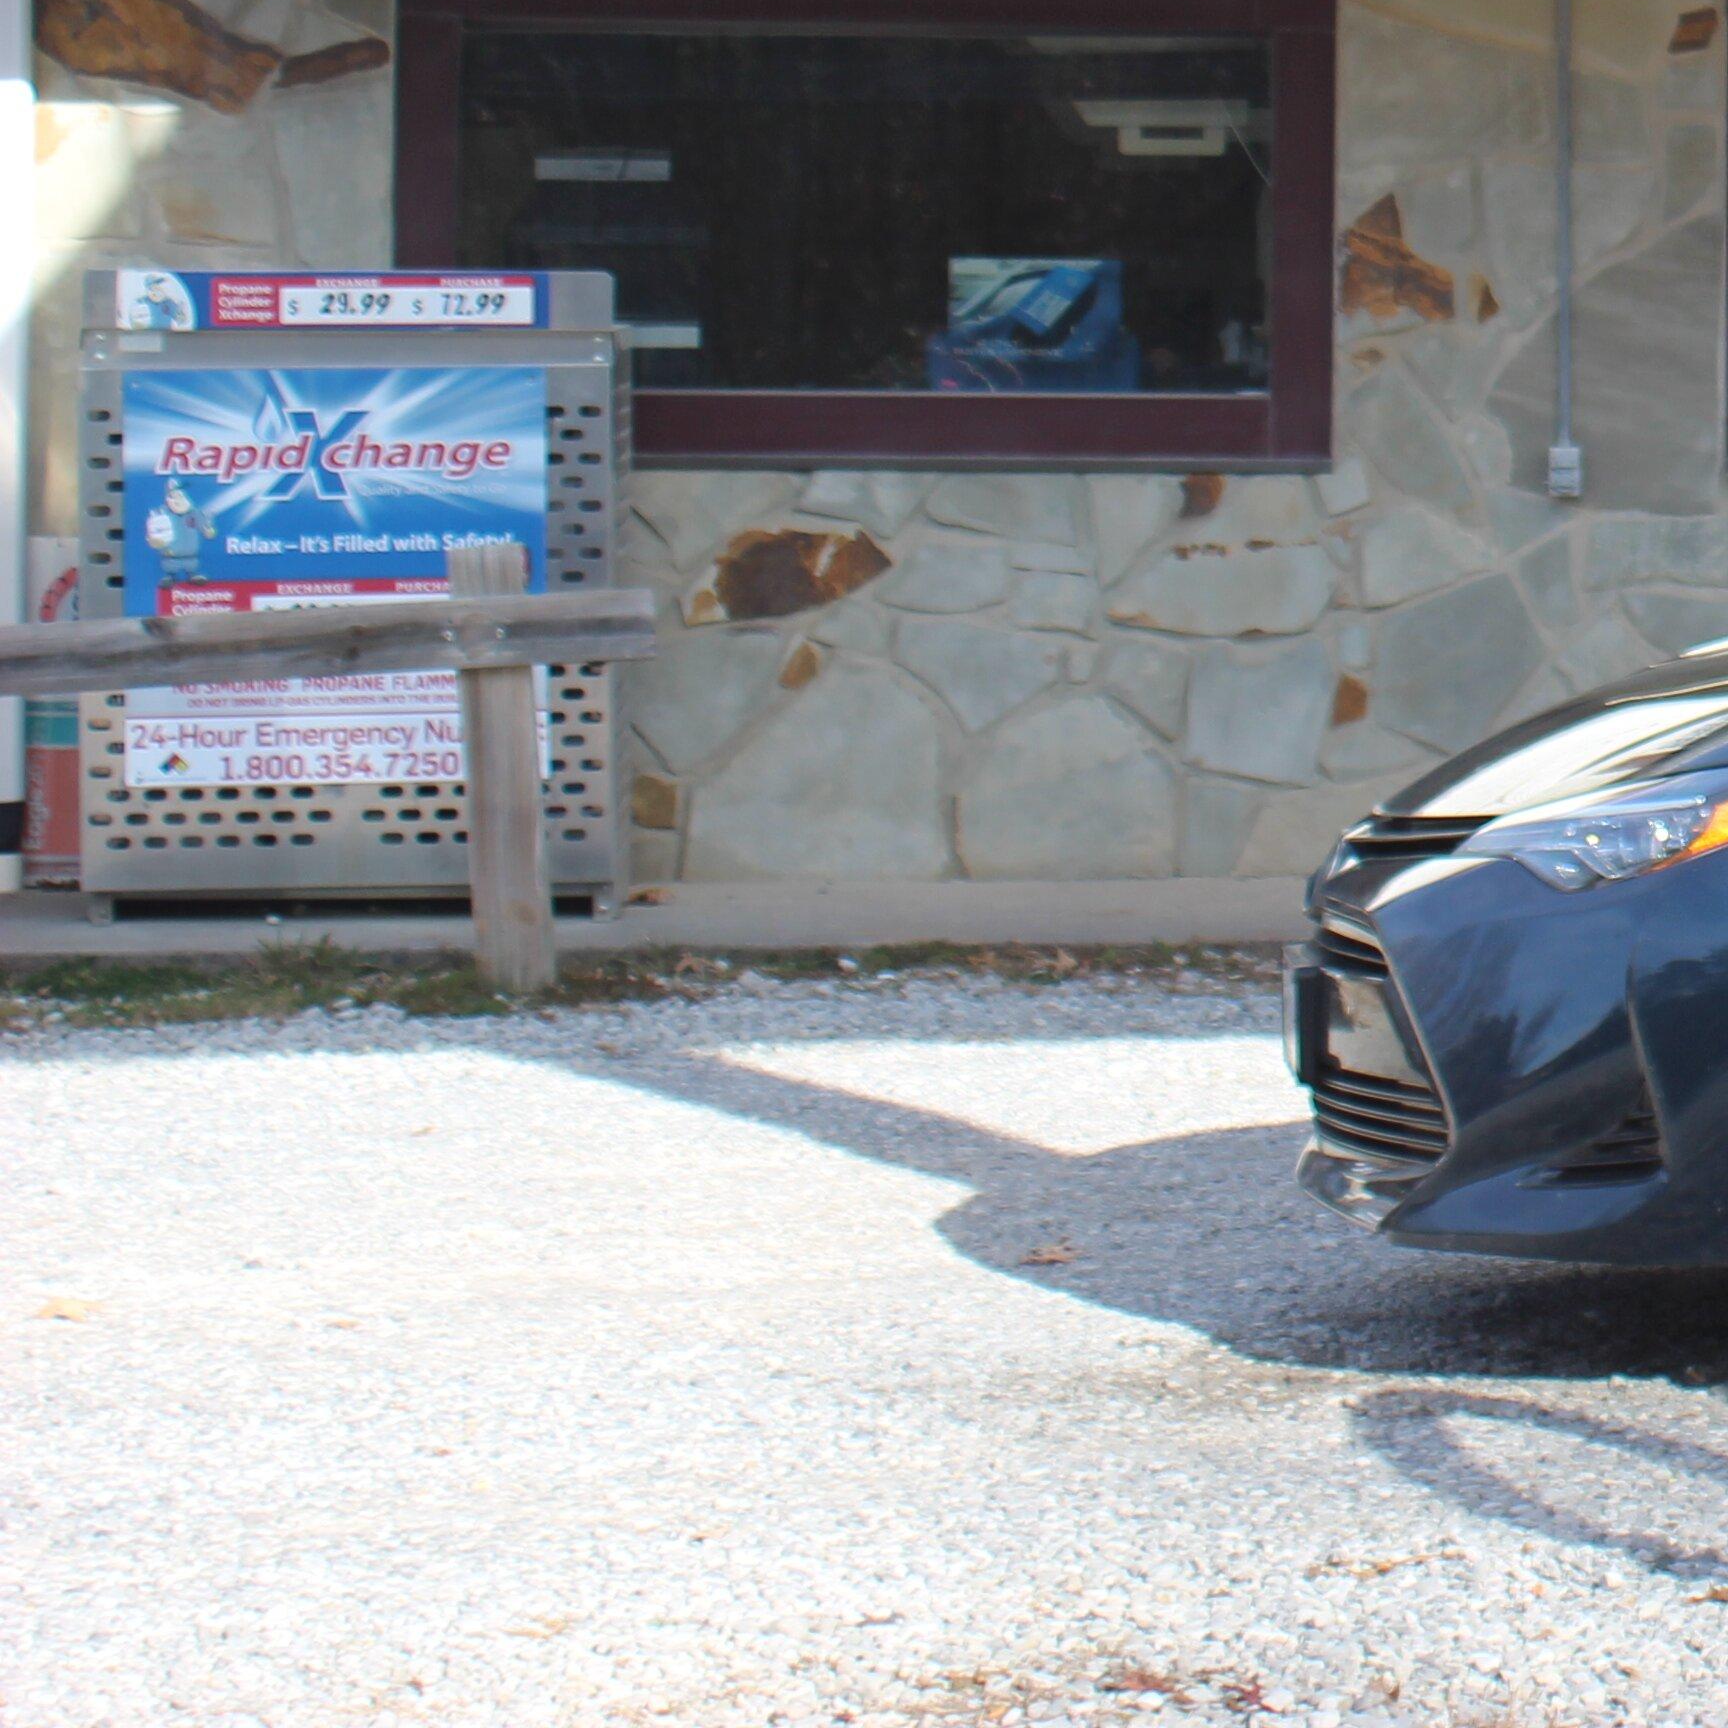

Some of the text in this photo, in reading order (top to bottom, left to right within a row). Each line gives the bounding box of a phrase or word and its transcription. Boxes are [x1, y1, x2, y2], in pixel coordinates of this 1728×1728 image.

[218, 283, 272, 297] Propane
[218, 296, 275, 309] Cylinder
[319, 293, 390, 315] 29.99
[218, 309, 273, 322] Xchange
[156, 434, 314, 483] Rapid
[333, 535, 388, 553] Filled
[394, 535, 437, 552] with
[276, 582, 353, 594] EXCHANGE
[395, 581, 449, 592] PURCHA
[171, 589, 233, 604] Propane
[204, 679, 289, 693] SMOKING
[302, 675, 385, 691] PROPANE
[392, 674, 455, 689] FLAMM
[131, 719, 462, 751] 24-Hour Emergency Nu
[220, 752, 458, 780] 1.800.354.7250
